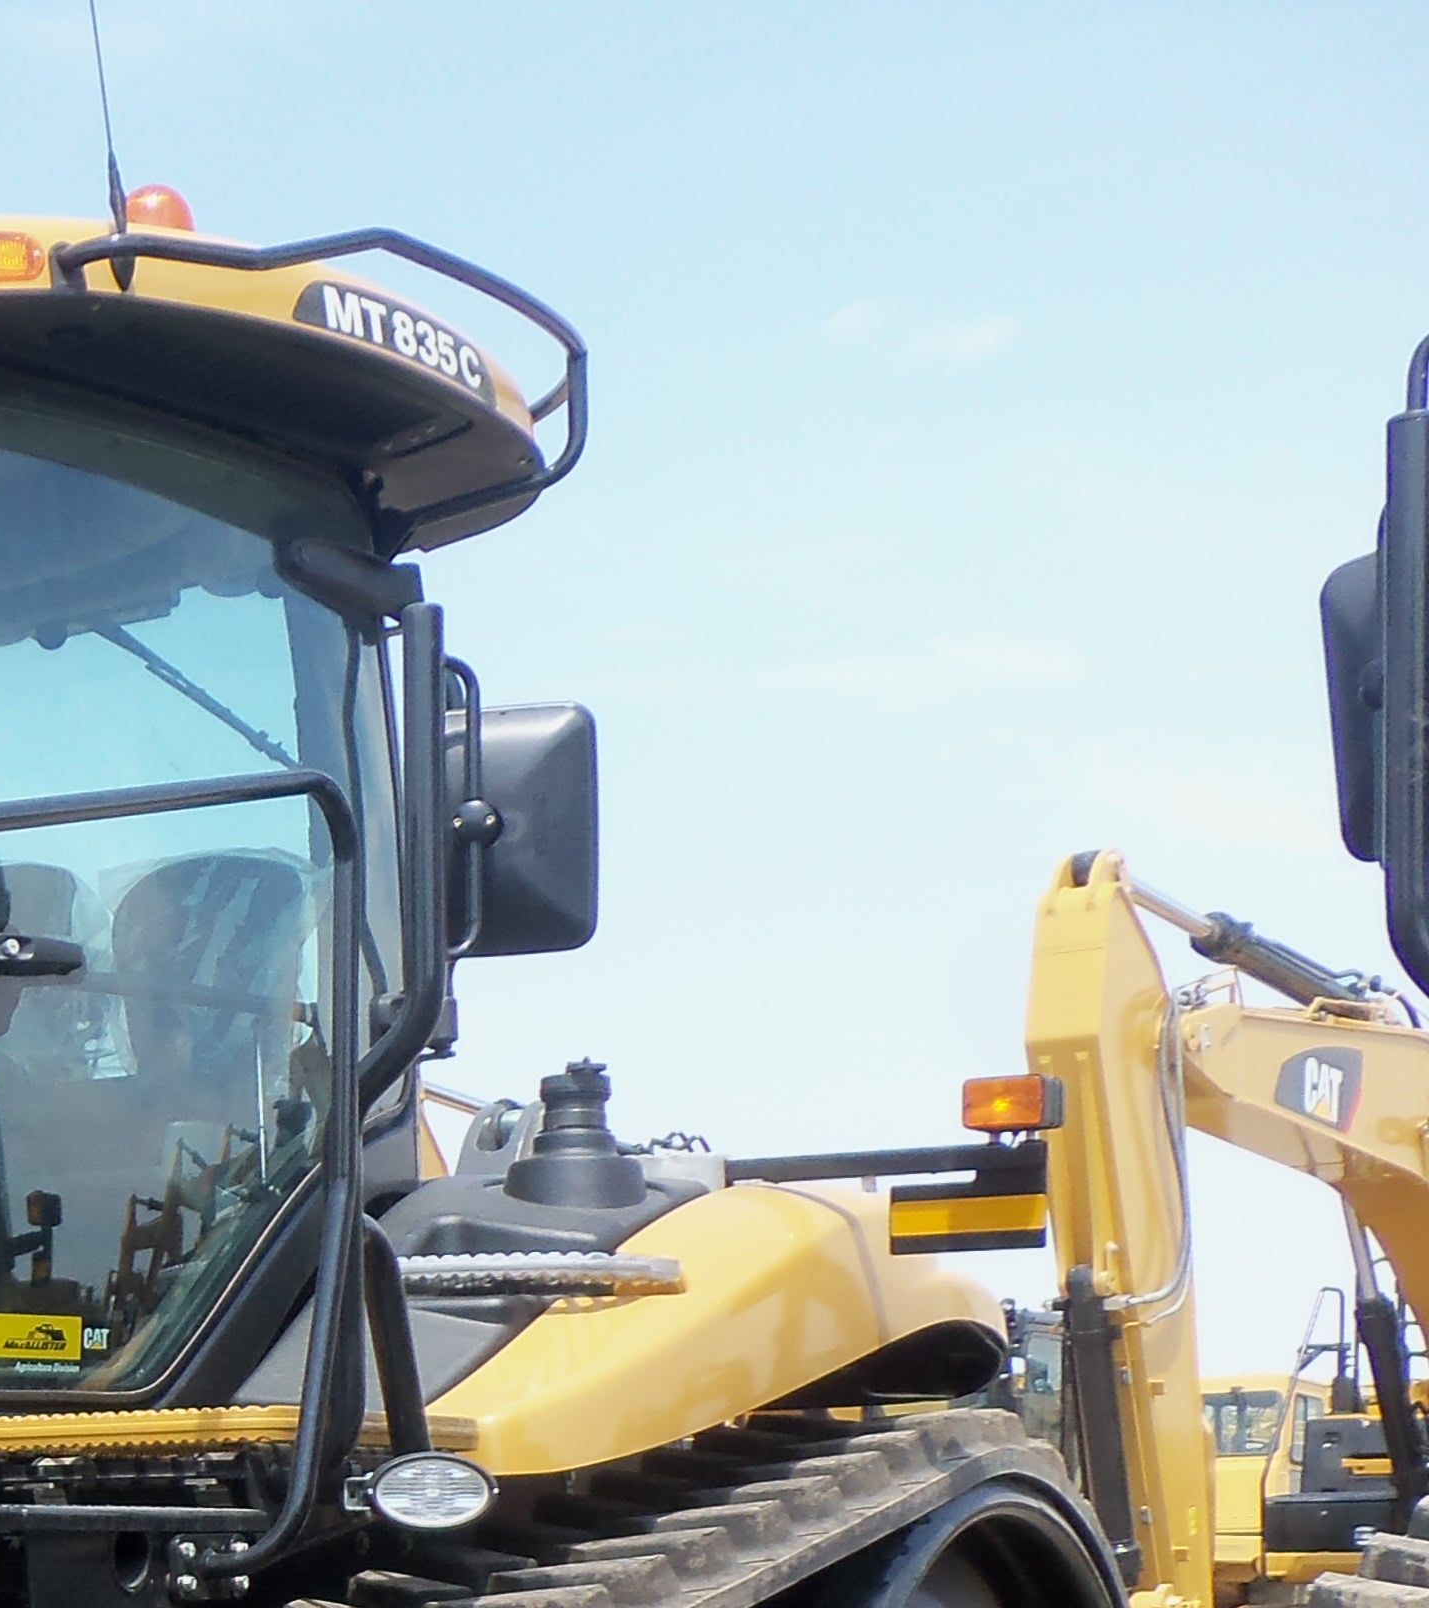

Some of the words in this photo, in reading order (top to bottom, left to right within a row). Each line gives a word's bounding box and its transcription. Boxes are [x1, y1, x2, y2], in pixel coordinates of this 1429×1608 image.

[322, 284, 387, 345] MT
[391, 309, 482, 388] 835C
[1303, 1056, 1344, 1123] CAT
[83, 1327, 110, 1350] CAT
